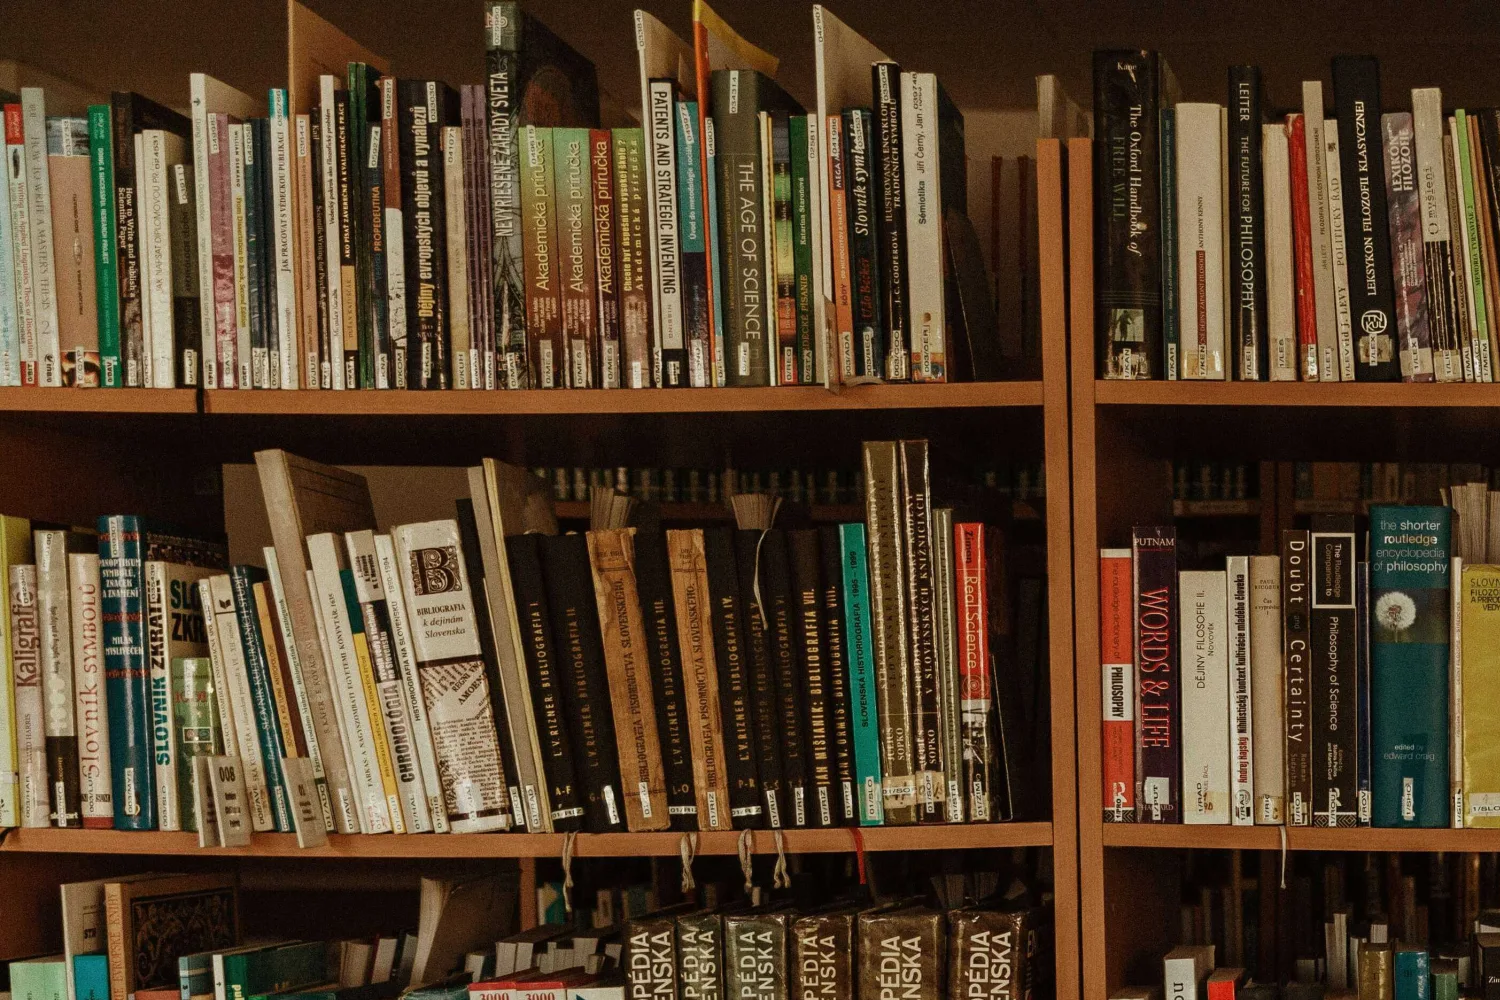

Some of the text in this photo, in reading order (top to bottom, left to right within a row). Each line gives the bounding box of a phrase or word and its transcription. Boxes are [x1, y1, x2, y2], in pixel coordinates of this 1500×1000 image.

[410, 106, 427, 155] vynálezů
[412, 172, 430, 208] objevů
[653, 90, 676, 294] PATENTS AND STRATEGIC INVENTING
[1127, 104, 1143, 257] The Oxford Handbook of
[1239, 82, 1255, 311] LEITER THE FUTURE FOR PHILOSOPHY
[1361, 177, 1373, 232] FILOZOFII
[568, 141, 584, 292] Akademická príručka
[416, 213, 433, 279] evropských
[738, 161, 760, 339] THE AGE OF SCIENCE
[1134, 537, 1174, 546] PUTNAM
[1376, 547, 1445, 559] encyclopedia
[1384, 534, 1437, 545] routledge
[1399, 520, 1440, 531] shorter
[1289, 541, 1304, 603] Doubt
[1373, 560, 1448, 574] of philosophy
[416, 603, 465, 616] BIBLIOGRAFIA
[425, 627, 466, 639] Slovenska
[966, 575, 978, 670] Real Science
[1140, 586, 1170, 673] WORDS
[1112, 666, 1124, 718] PHILOSOPHY
[1288, 640, 1306, 742] Certainty
[1329, 616, 1339, 731] Philosophy of Science
